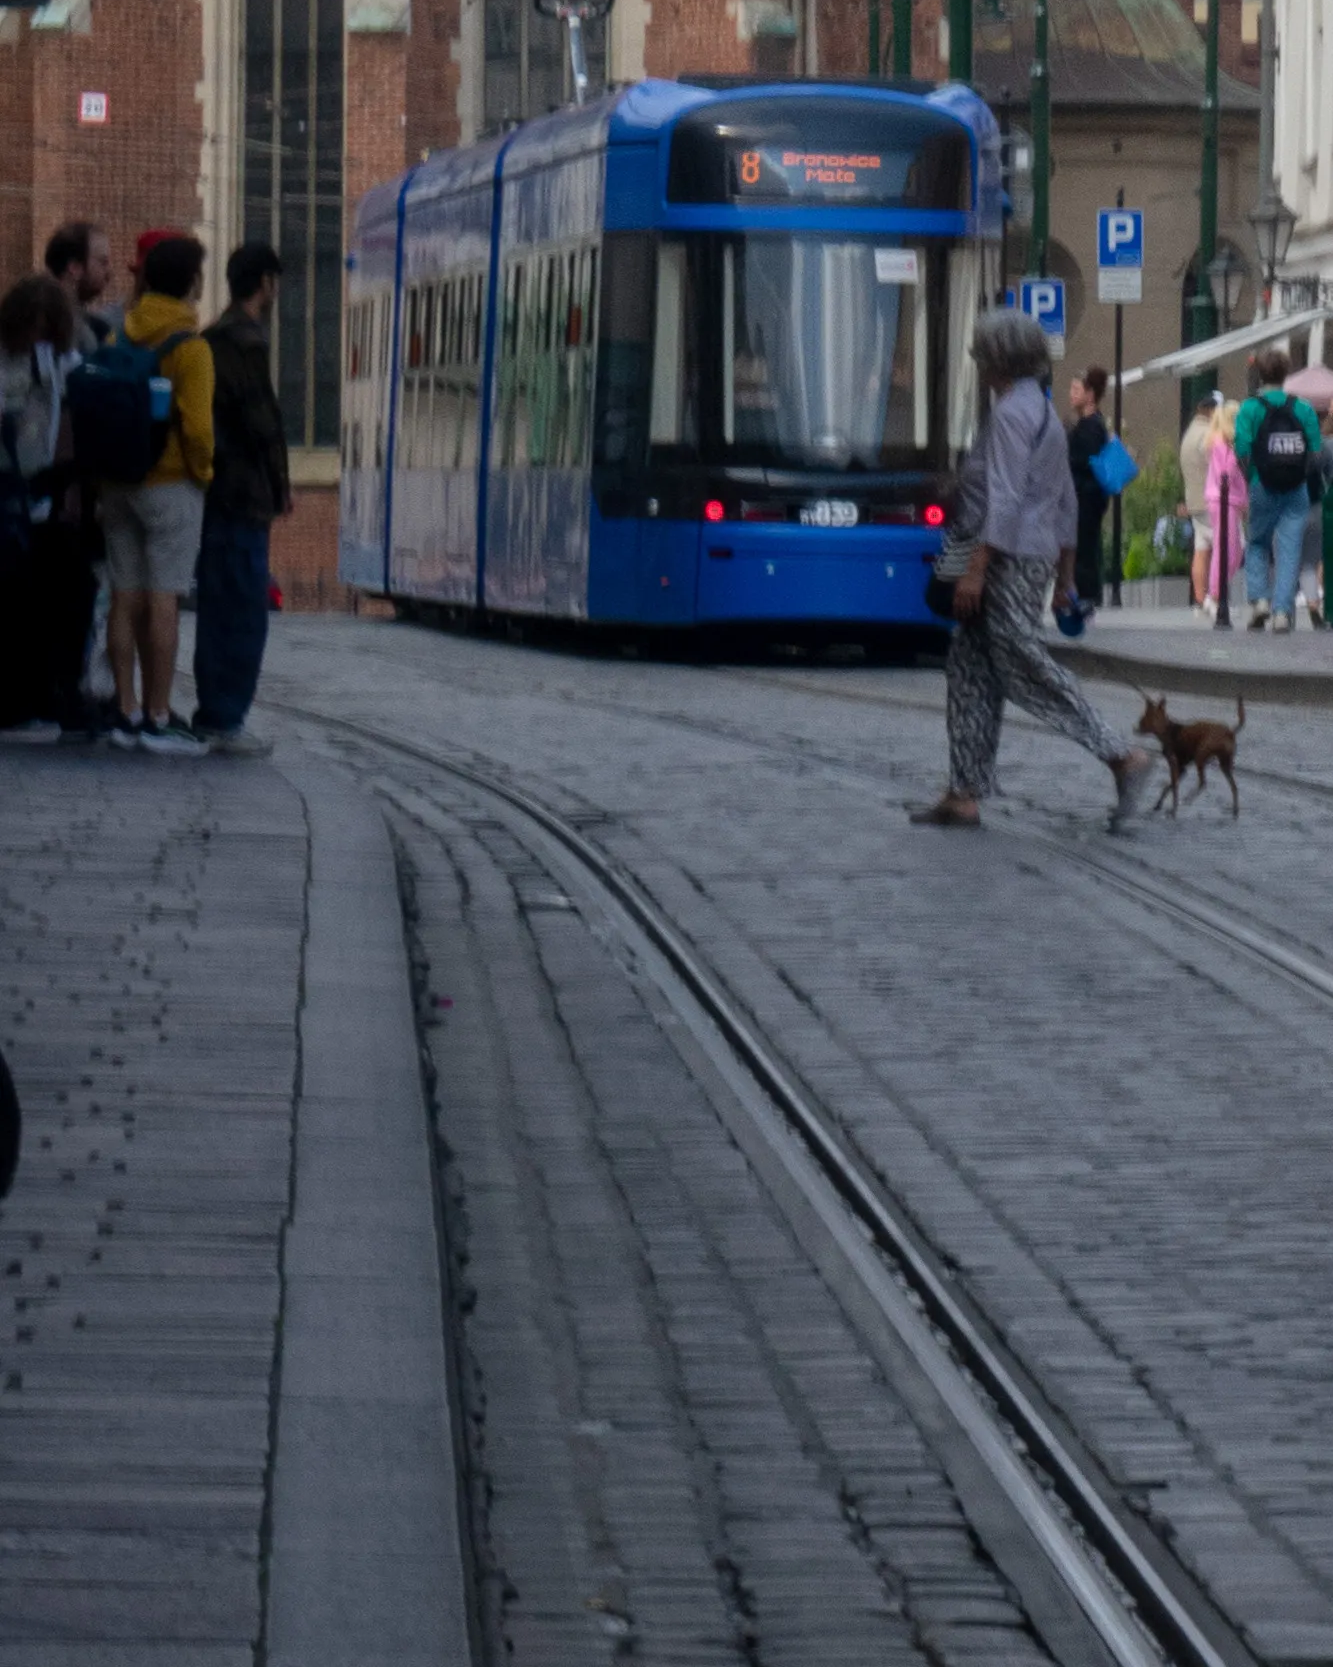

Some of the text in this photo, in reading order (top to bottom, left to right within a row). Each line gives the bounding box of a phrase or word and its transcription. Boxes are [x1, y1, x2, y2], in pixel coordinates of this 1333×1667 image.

[741, 151, 760, 184] 8
[1108, 214, 1135, 253] P
[1031, 283, 1056, 323] P
